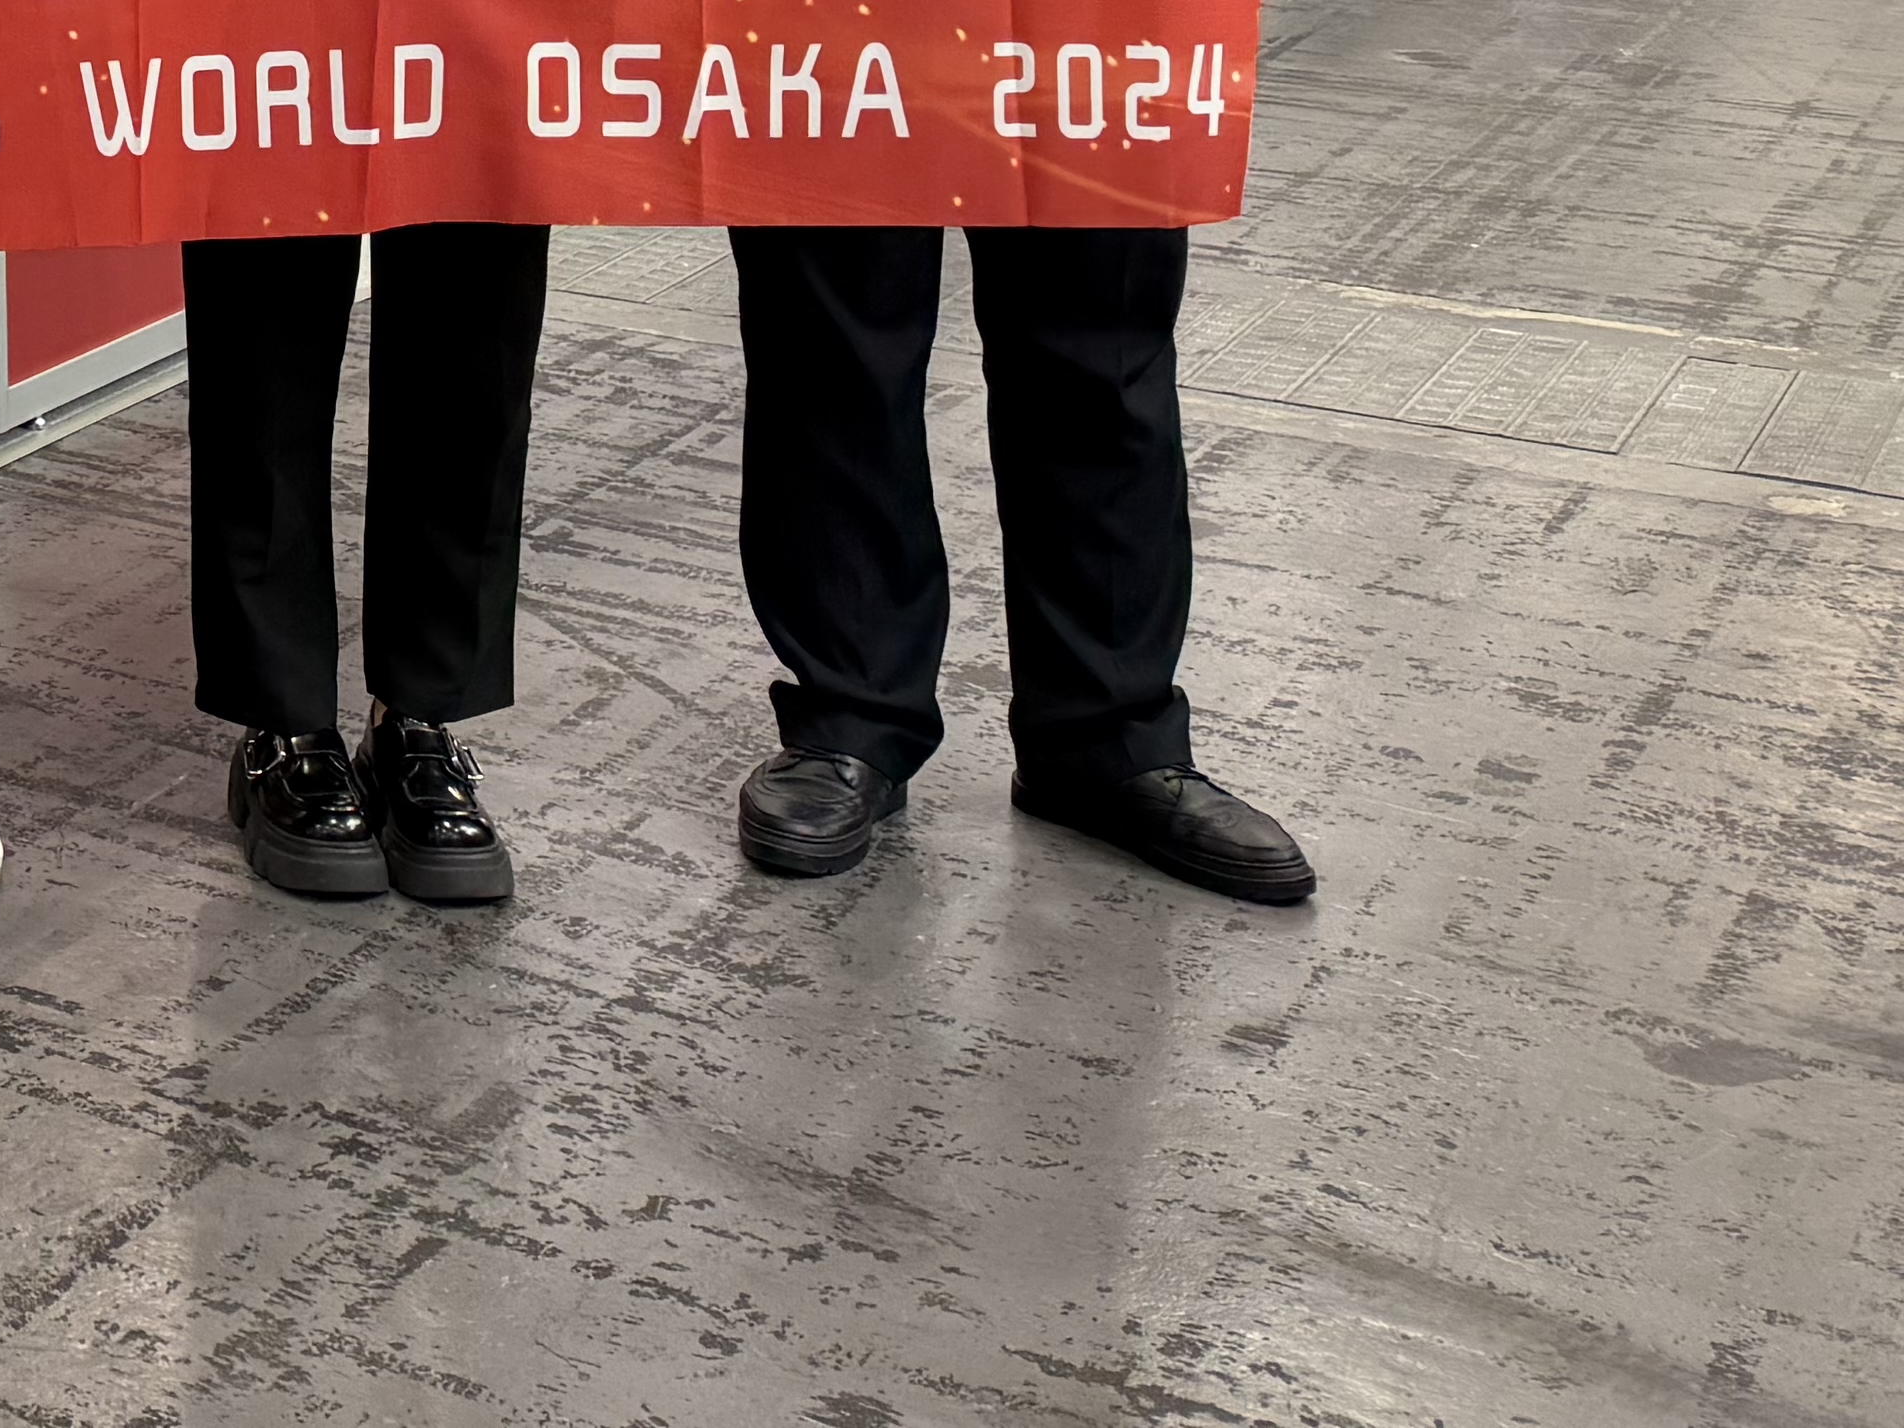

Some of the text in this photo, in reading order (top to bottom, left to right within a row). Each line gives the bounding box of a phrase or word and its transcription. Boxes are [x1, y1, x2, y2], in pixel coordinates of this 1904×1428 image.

[83, 42, 446, 158] WORLD
[525, 40, 904, 145] OSAKA
[990, 40, 1225, 145] 2024
